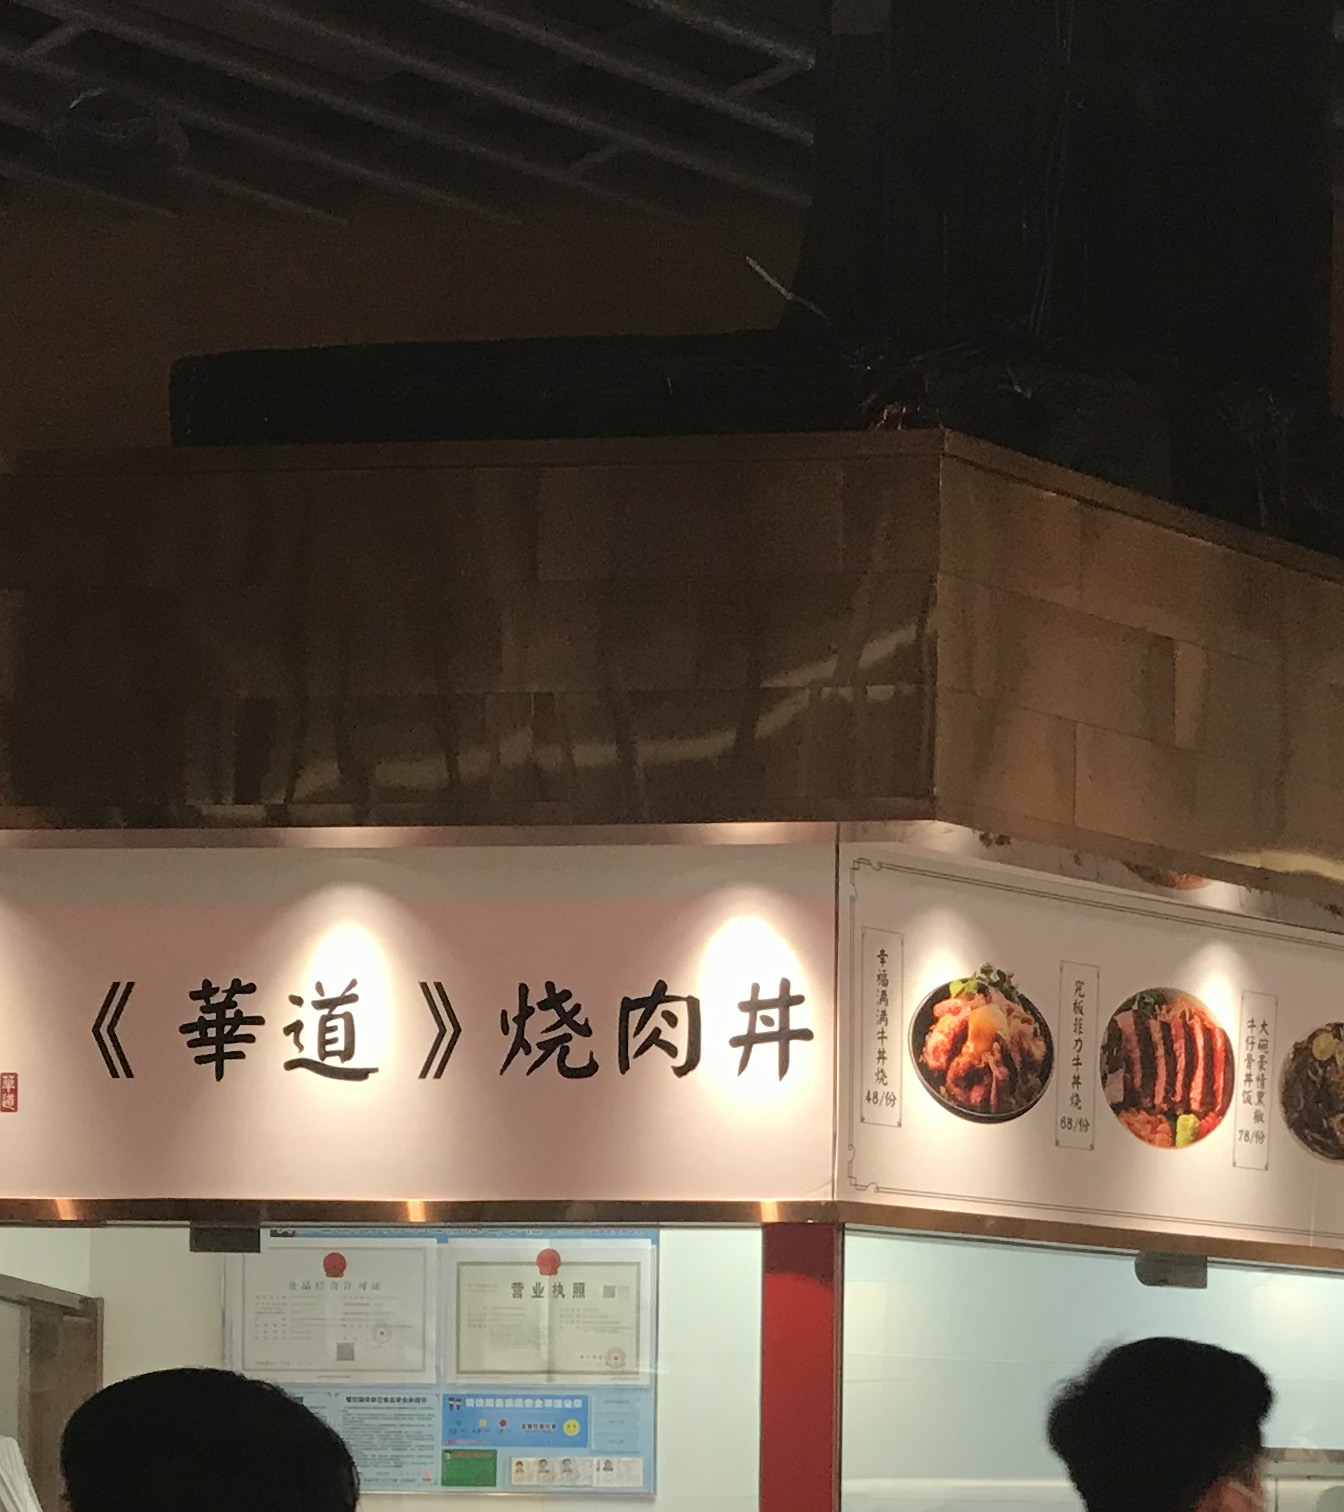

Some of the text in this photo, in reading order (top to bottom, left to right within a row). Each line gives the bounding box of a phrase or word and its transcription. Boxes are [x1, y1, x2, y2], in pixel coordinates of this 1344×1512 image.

[865, 1089, 897, 1108] 48/份
[510, 1281, 587, 1300] 营业执照
